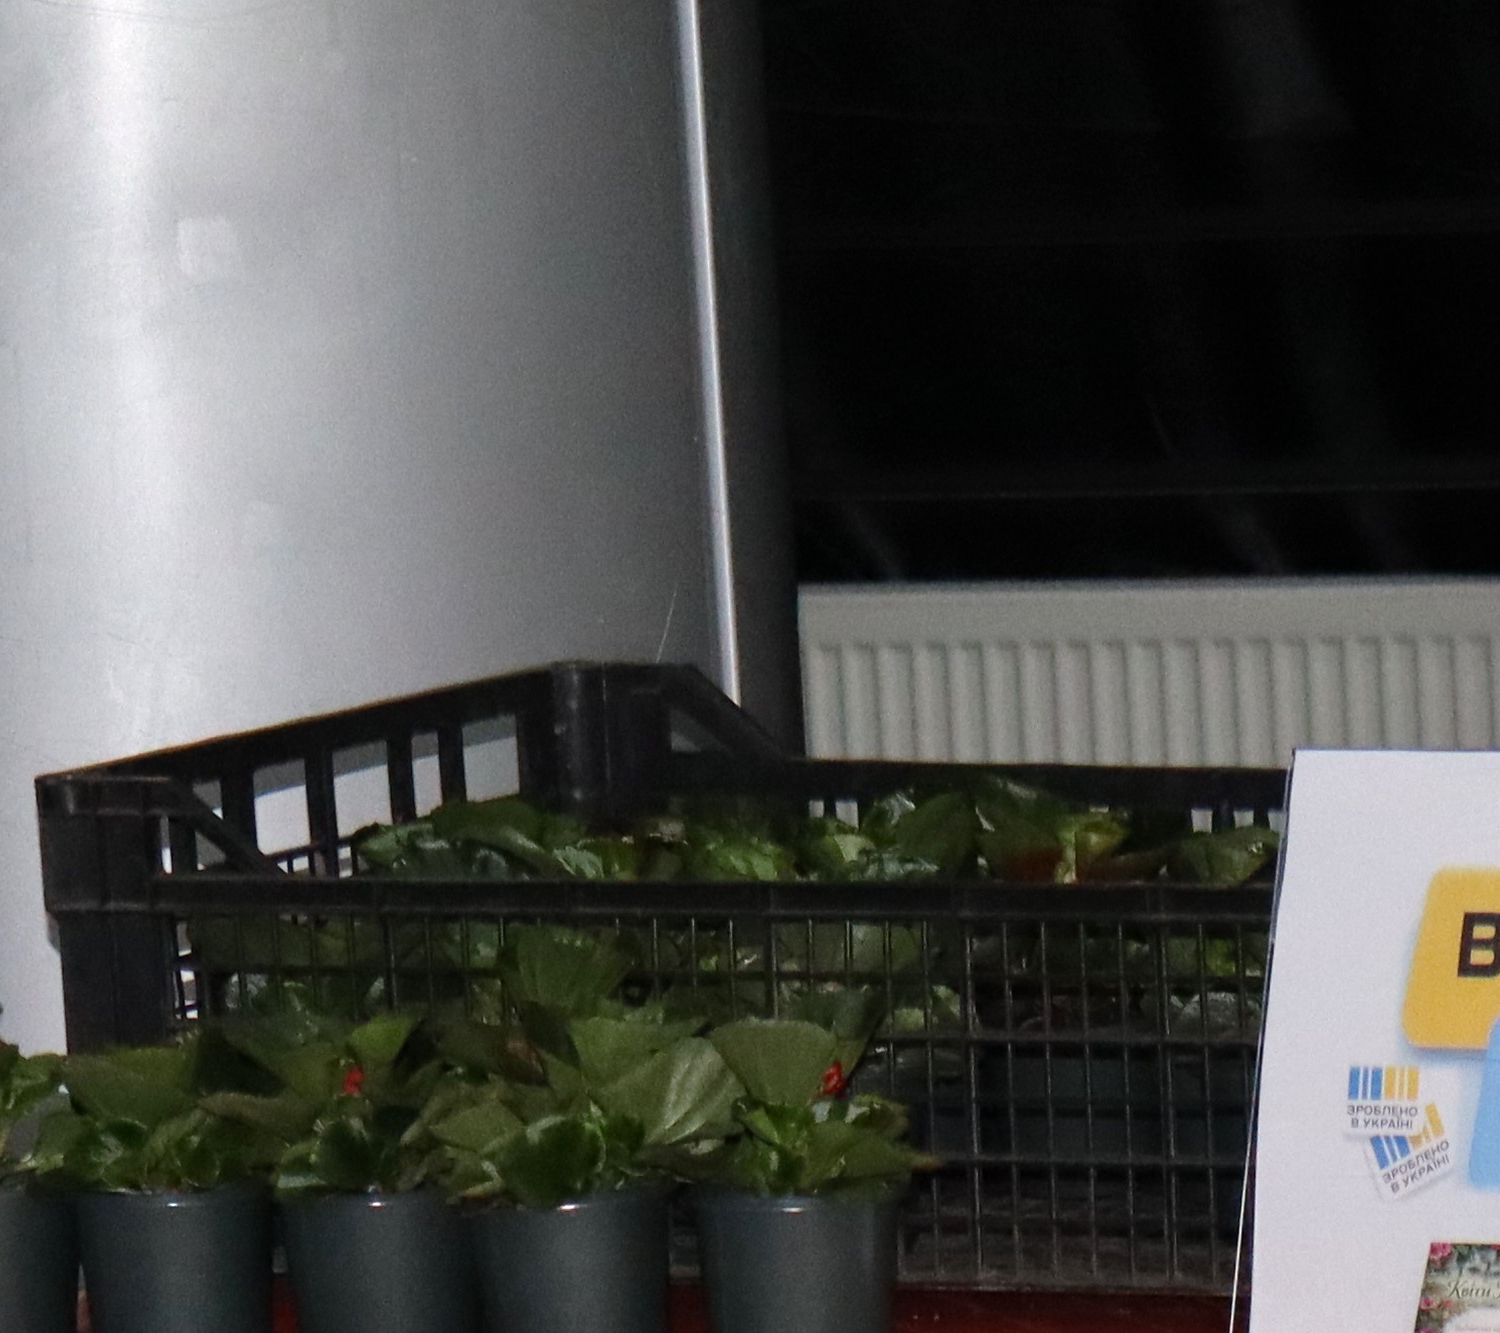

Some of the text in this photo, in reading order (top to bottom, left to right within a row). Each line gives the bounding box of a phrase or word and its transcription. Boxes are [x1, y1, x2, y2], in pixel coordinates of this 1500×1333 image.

[1347, 1104, 1418, 1118] ЗРОБЛЕНО
[1351, 1117, 1413, 1129] В УКРАЇНІ
[1382, 1140, 1450, 1184] ЗРОБЛЕНО
[1390, 1154, 1450, 1194] В УКРАЇНІ
